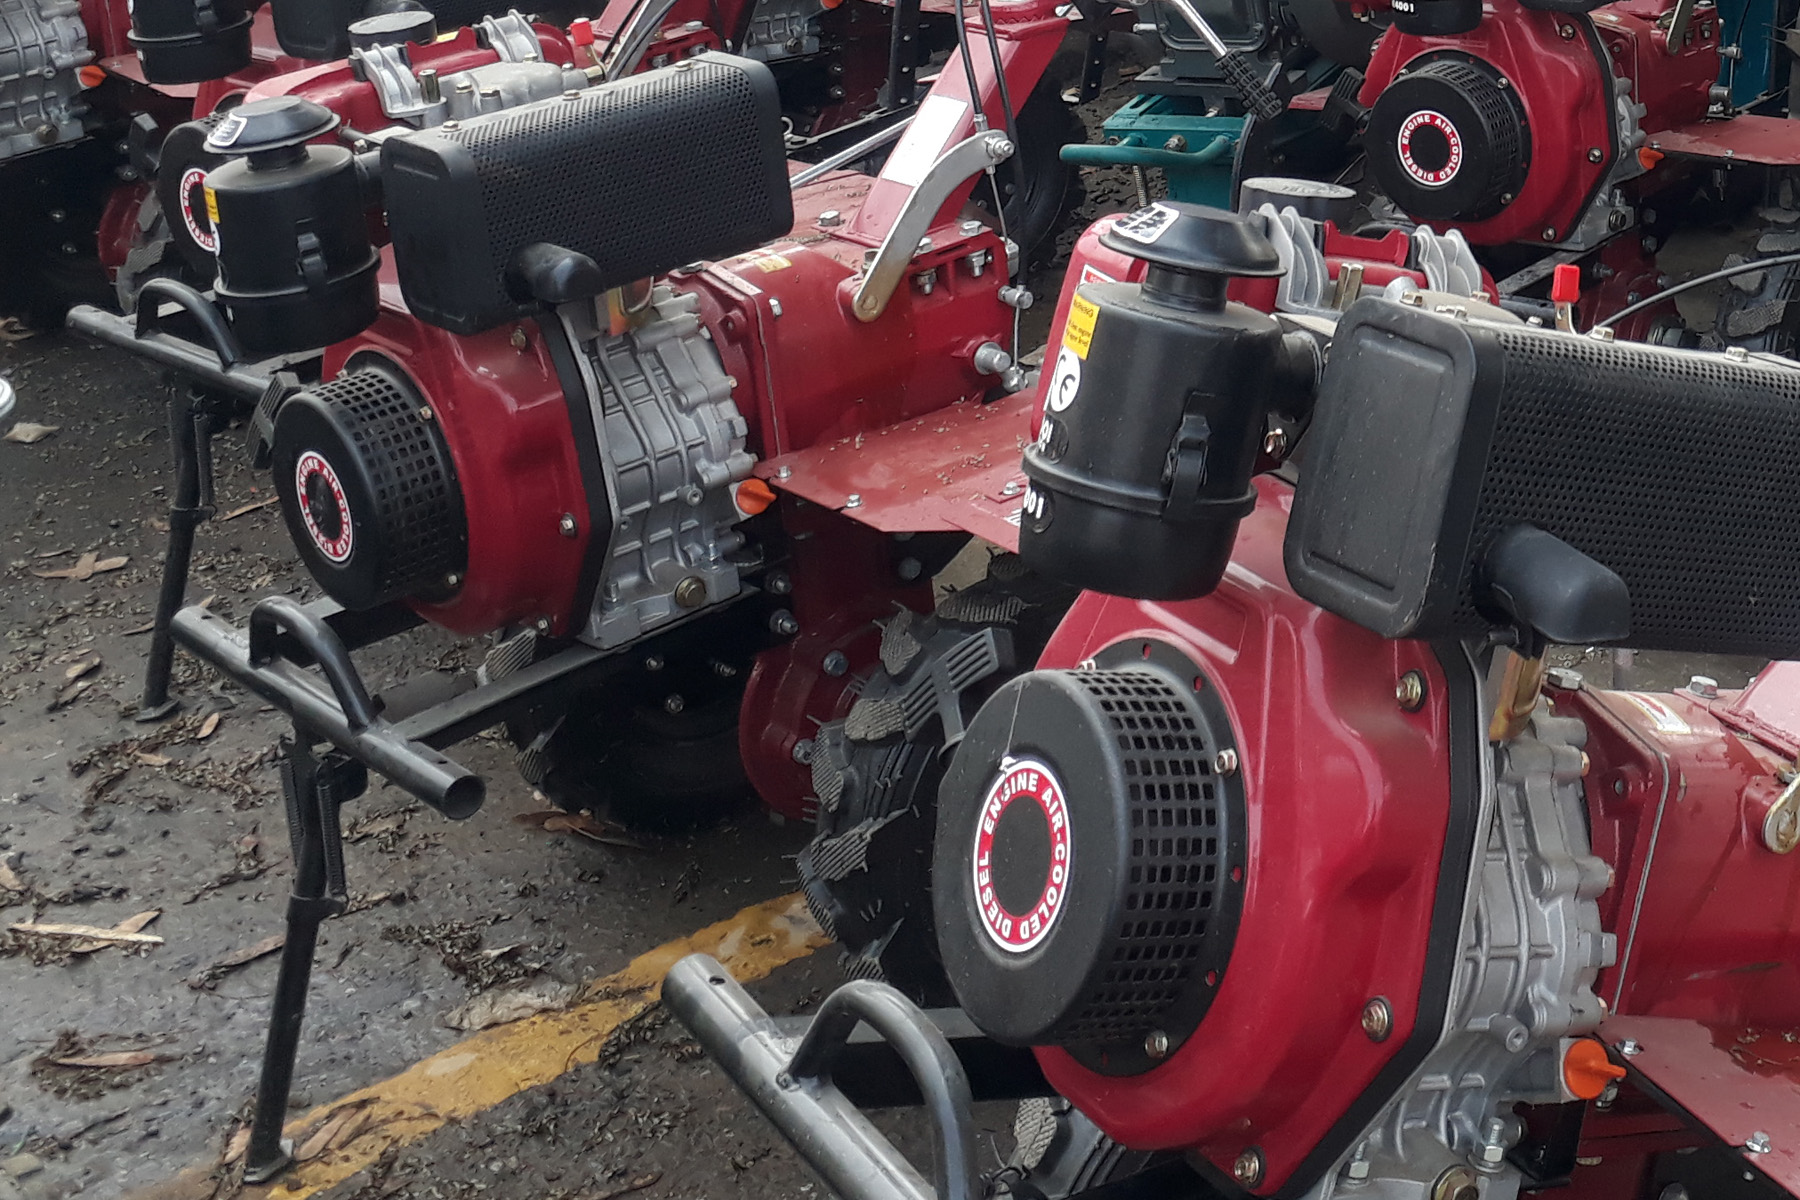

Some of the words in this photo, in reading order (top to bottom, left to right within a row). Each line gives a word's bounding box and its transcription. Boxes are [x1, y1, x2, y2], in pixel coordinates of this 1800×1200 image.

[1401, 114, 1431, 145] ENGINE
[1435, 118, 1459, 179] AIR-COOLED
[1404, 150, 1434, 181] DIESEL
[299, 458, 320, 496] ENGINE
[322, 467, 350, 555] AIR-COOLED
[983, 771, 1039, 836] ENGINE
[978, 850, 1012, 940] DIESEL
[1019, 787, 1066, 940] AIR-COOLED
